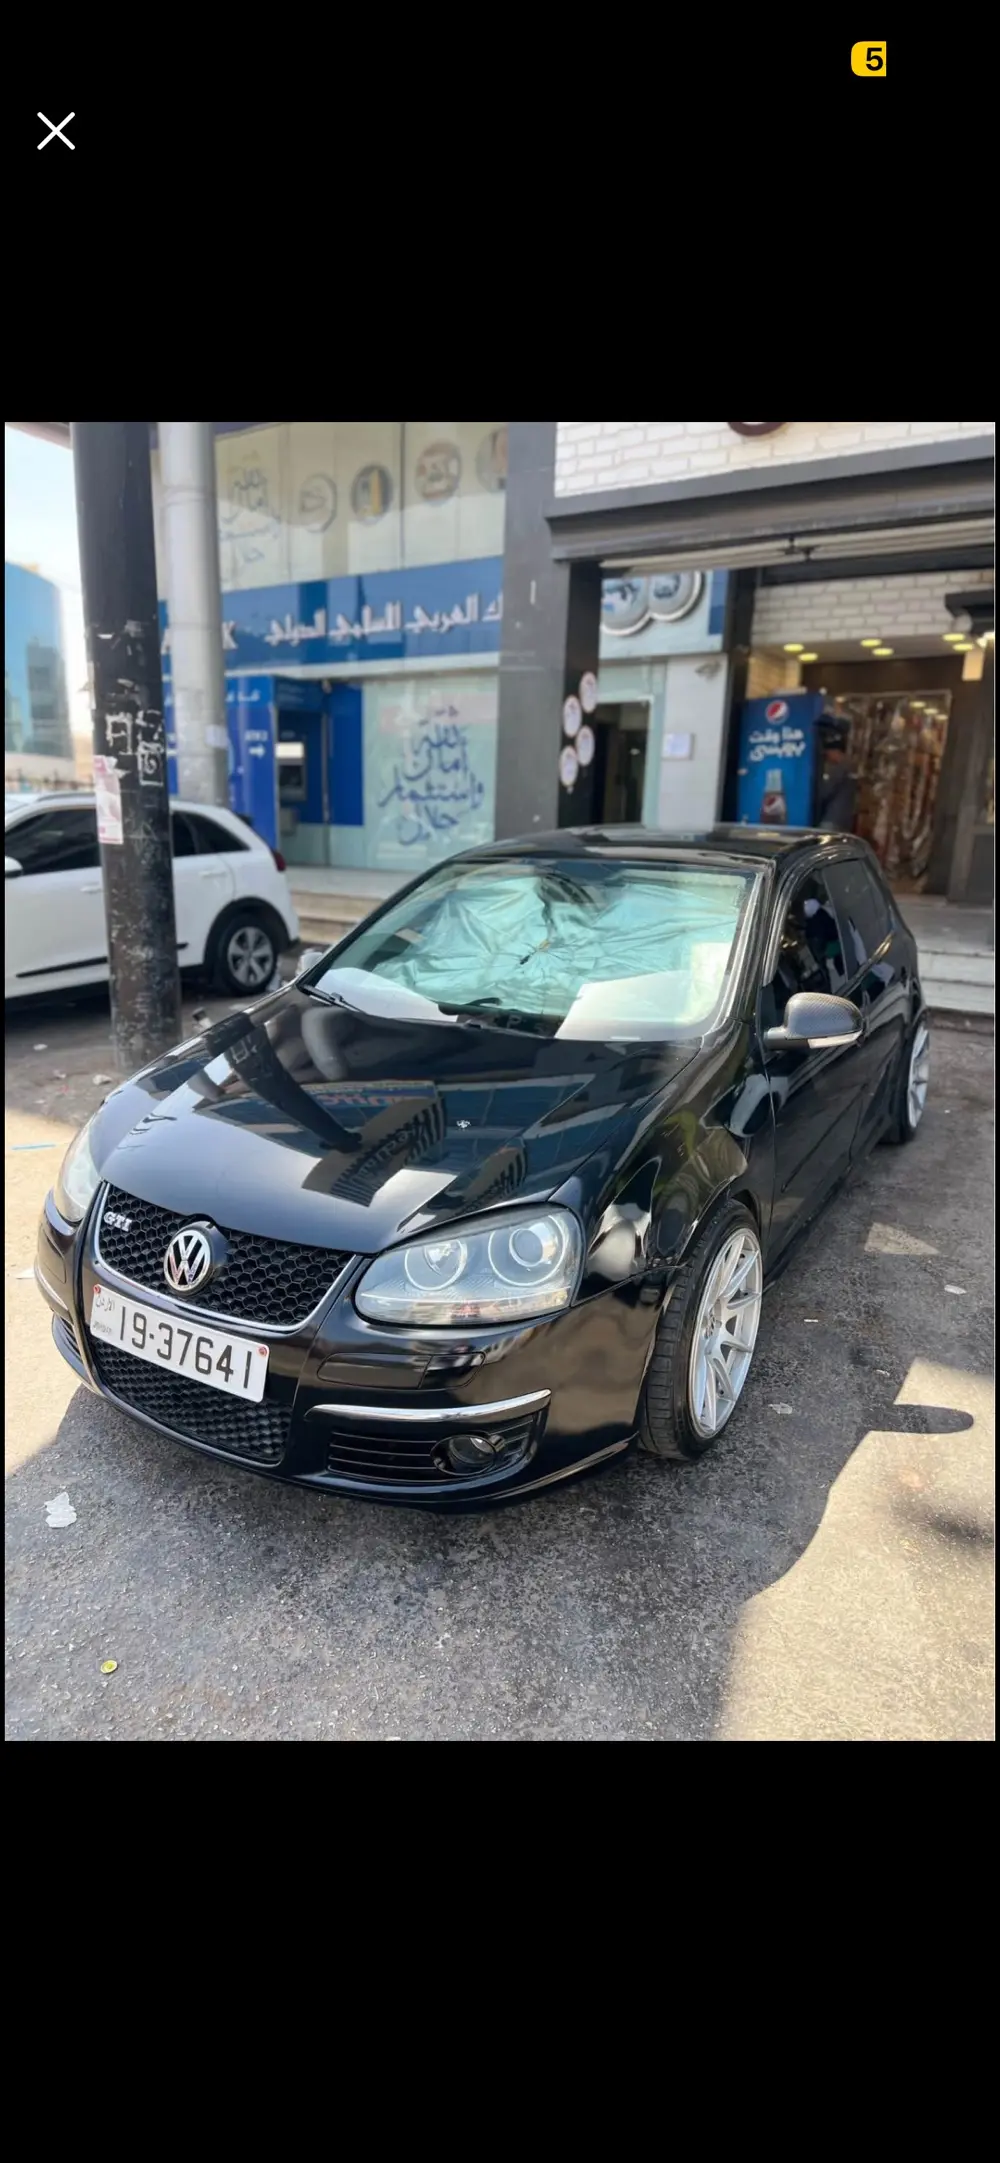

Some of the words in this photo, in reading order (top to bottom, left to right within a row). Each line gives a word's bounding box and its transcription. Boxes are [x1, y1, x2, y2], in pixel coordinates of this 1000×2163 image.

[264, 608, 327, 647] الدولي
[404, 592, 479, 634] العربي
[103, 1211, 133, 1233] GTI
[119, 1306, 253, 1389] 19-37641
